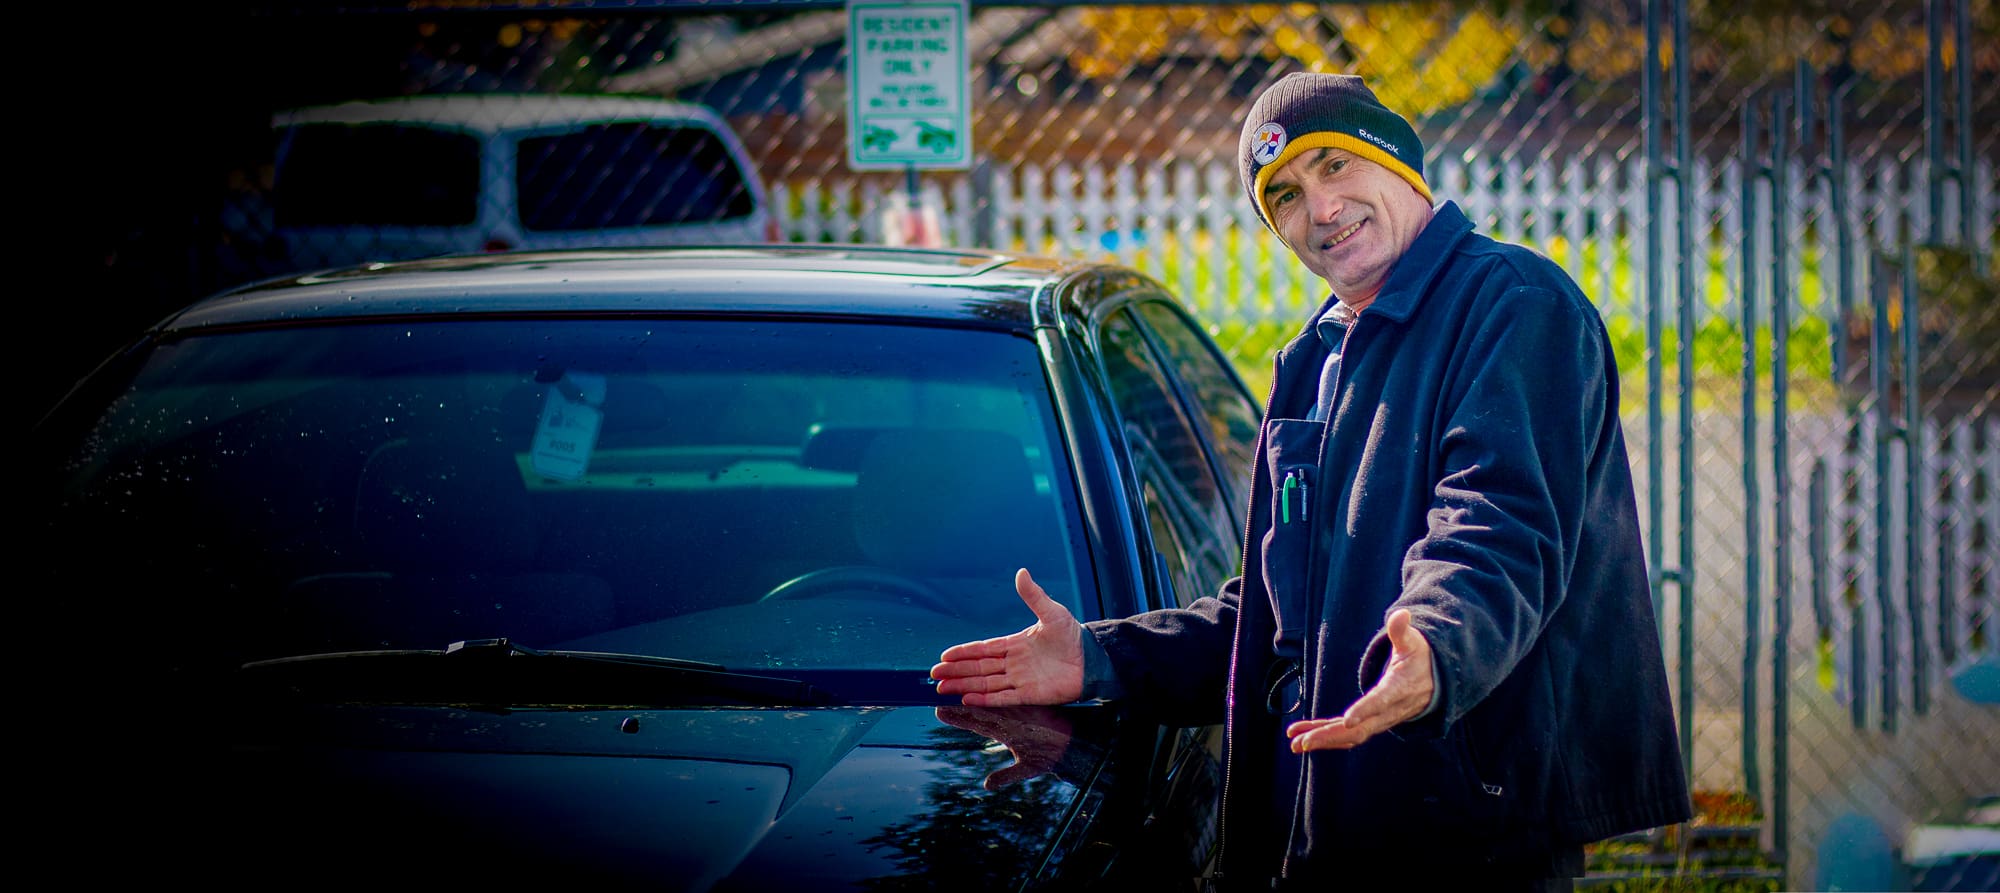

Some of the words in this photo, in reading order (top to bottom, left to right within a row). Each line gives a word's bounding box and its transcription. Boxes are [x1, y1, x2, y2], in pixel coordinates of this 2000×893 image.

[863, 17, 949, 32] RESIDENT
[867, 39, 948, 53] PARKING
[884, 60, 932, 75] ONLY
[1358, 129, 1400, 155] Reebok
